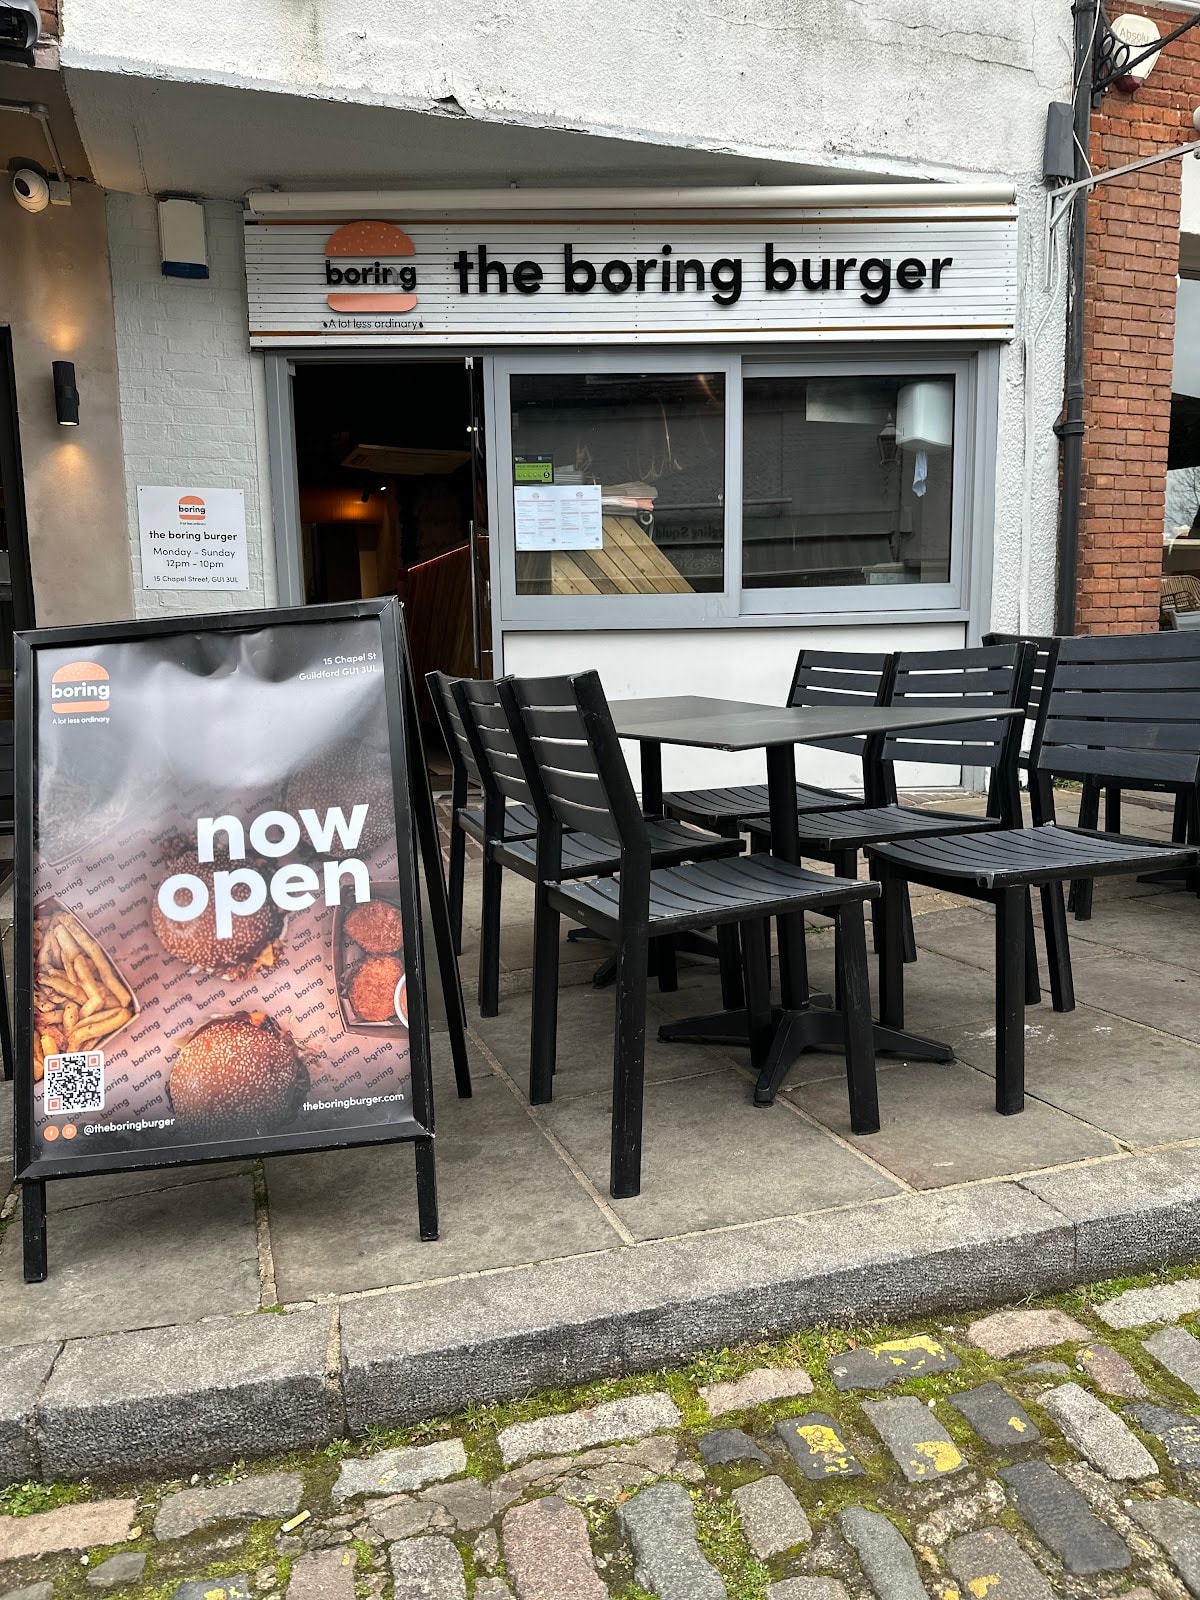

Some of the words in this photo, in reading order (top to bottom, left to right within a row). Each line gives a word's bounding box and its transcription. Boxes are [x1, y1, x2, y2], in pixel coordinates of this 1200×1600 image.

[325, 259, 417, 291] boring
[453, 244, 544, 294] the
[564, 243, 743, 305] boring
[765, 242, 953, 305] burger
[329, 319, 337, 329] A
[338, 319, 350, 329] lot
[353, 319, 372, 329] less
[374, 319, 418, 331] ordinary
[179, 505, 206, 515] boring
[148, 530, 166, 539] the
[168, 530, 201, 542] boring
[203, 531, 238, 543] burger
[153, 547, 192, 558] Monday
[201, 548, 236, 559] Sunday
[166, 559, 190, 569] 12pm
[200, 560, 224, 570] 10pm
[162, 575, 187, 583] Chapel
[323, 657, 332, 666] 15
[334, 653, 366, 666] Chapel
[367, 652, 377, 662] St
[298, 669, 342, 681] Guildford
[343, 667, 360, 677] GU1
[51, 682, 110, 701] boring
[67, 717, 80, 725] less
[81, 715, 110, 725] ordinary
[197, 804, 369, 863] now
[86, 852, 115, 872] boring
[118, 850, 147, 870] boring
[376, 851, 397, 869] borin
[33, 881, 53, 898] oring
[55, 878, 83, 898] boring
[86, 875, 115, 896] boring
[118, 873, 148, 893] boring
[119, 896, 148, 916] boring
[157, 855, 371, 939] open
[87, 899, 116, 919] boring
[288, 905, 311, 922] oring
[314, 905, 335, 922] borin
[93, 922, 117, 940] oring
[120, 920, 149, 940] boring
[293, 954, 322, 975] boring
[229, 985, 259, 1007] boring
[262, 981, 291, 1003] boring
[295, 976, 324, 999] boring
[139, 996, 160, 1013] oring
[163, 992, 193, 1014] boring
[196, 989, 226, 1010] boring
[296, 1001, 325, 1023] boring
[131, 1020, 160, 1042] boring
[164, 1017, 194, 1038] boring
[103, 1048, 129, 1069] oring
[131, 1044, 162, 1067] boring
[331, 1046, 360, 1067] boring
[104, 1073, 129, 1094] oring
[132, 1070, 162, 1092] boring
[332, 1071, 361, 1092] boring
[365, 1066, 394, 1089] boring
[101, 1098, 130, 1120] boring
[133, 1094, 163, 1117] boring
[302, 1093, 405, 1112] theboringburger.com
[84, 1118, 176, 1136] @theboringburger
